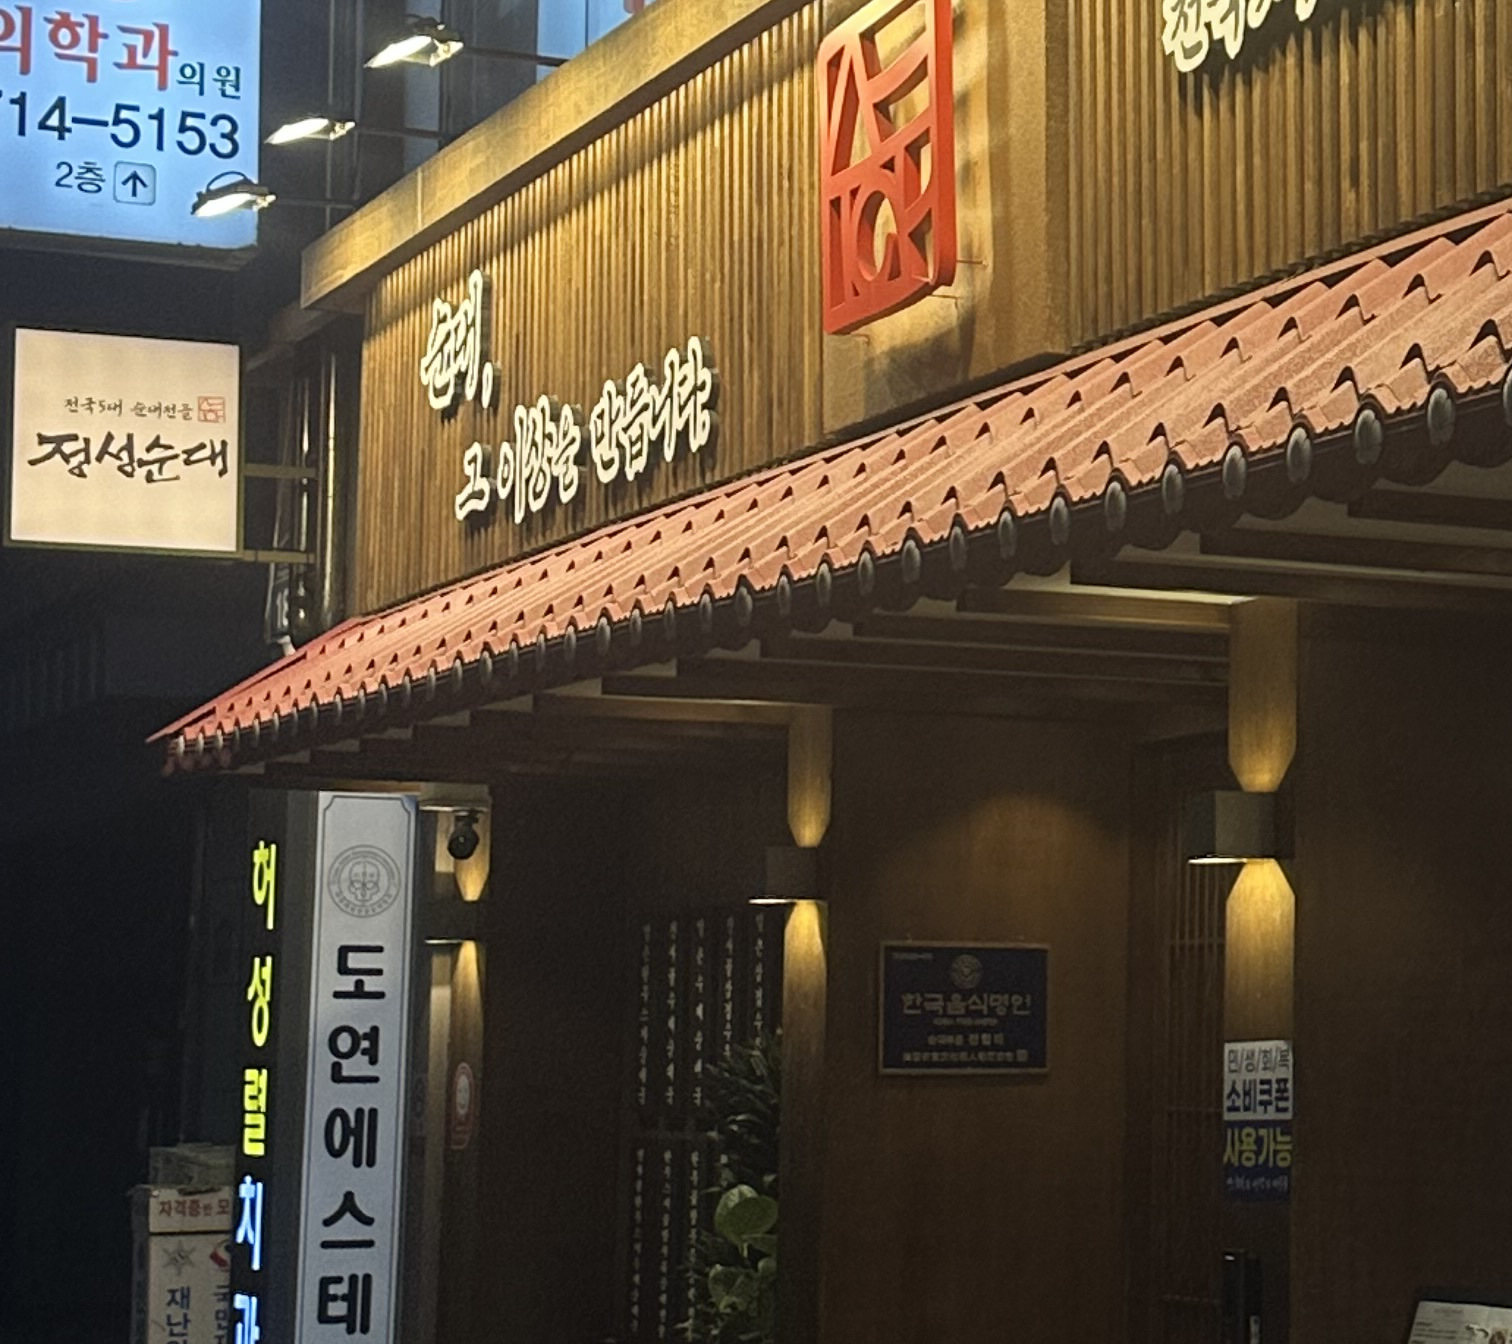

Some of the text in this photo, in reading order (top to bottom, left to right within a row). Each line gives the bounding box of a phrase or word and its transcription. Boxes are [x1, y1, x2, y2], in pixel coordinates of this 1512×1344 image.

[0, 4, 241, 100] 의학과 의원
[0, 90, 240, 159] 14-5153
[54, 160, 106, 194] 2층
[27, 430, 229, 484] 정성순대
[454, 441, 491, 522] 그
[1226, 1077, 1291, 1114] 소비쿠폰
[1222, 1126, 1292, 1169] 사용가능
